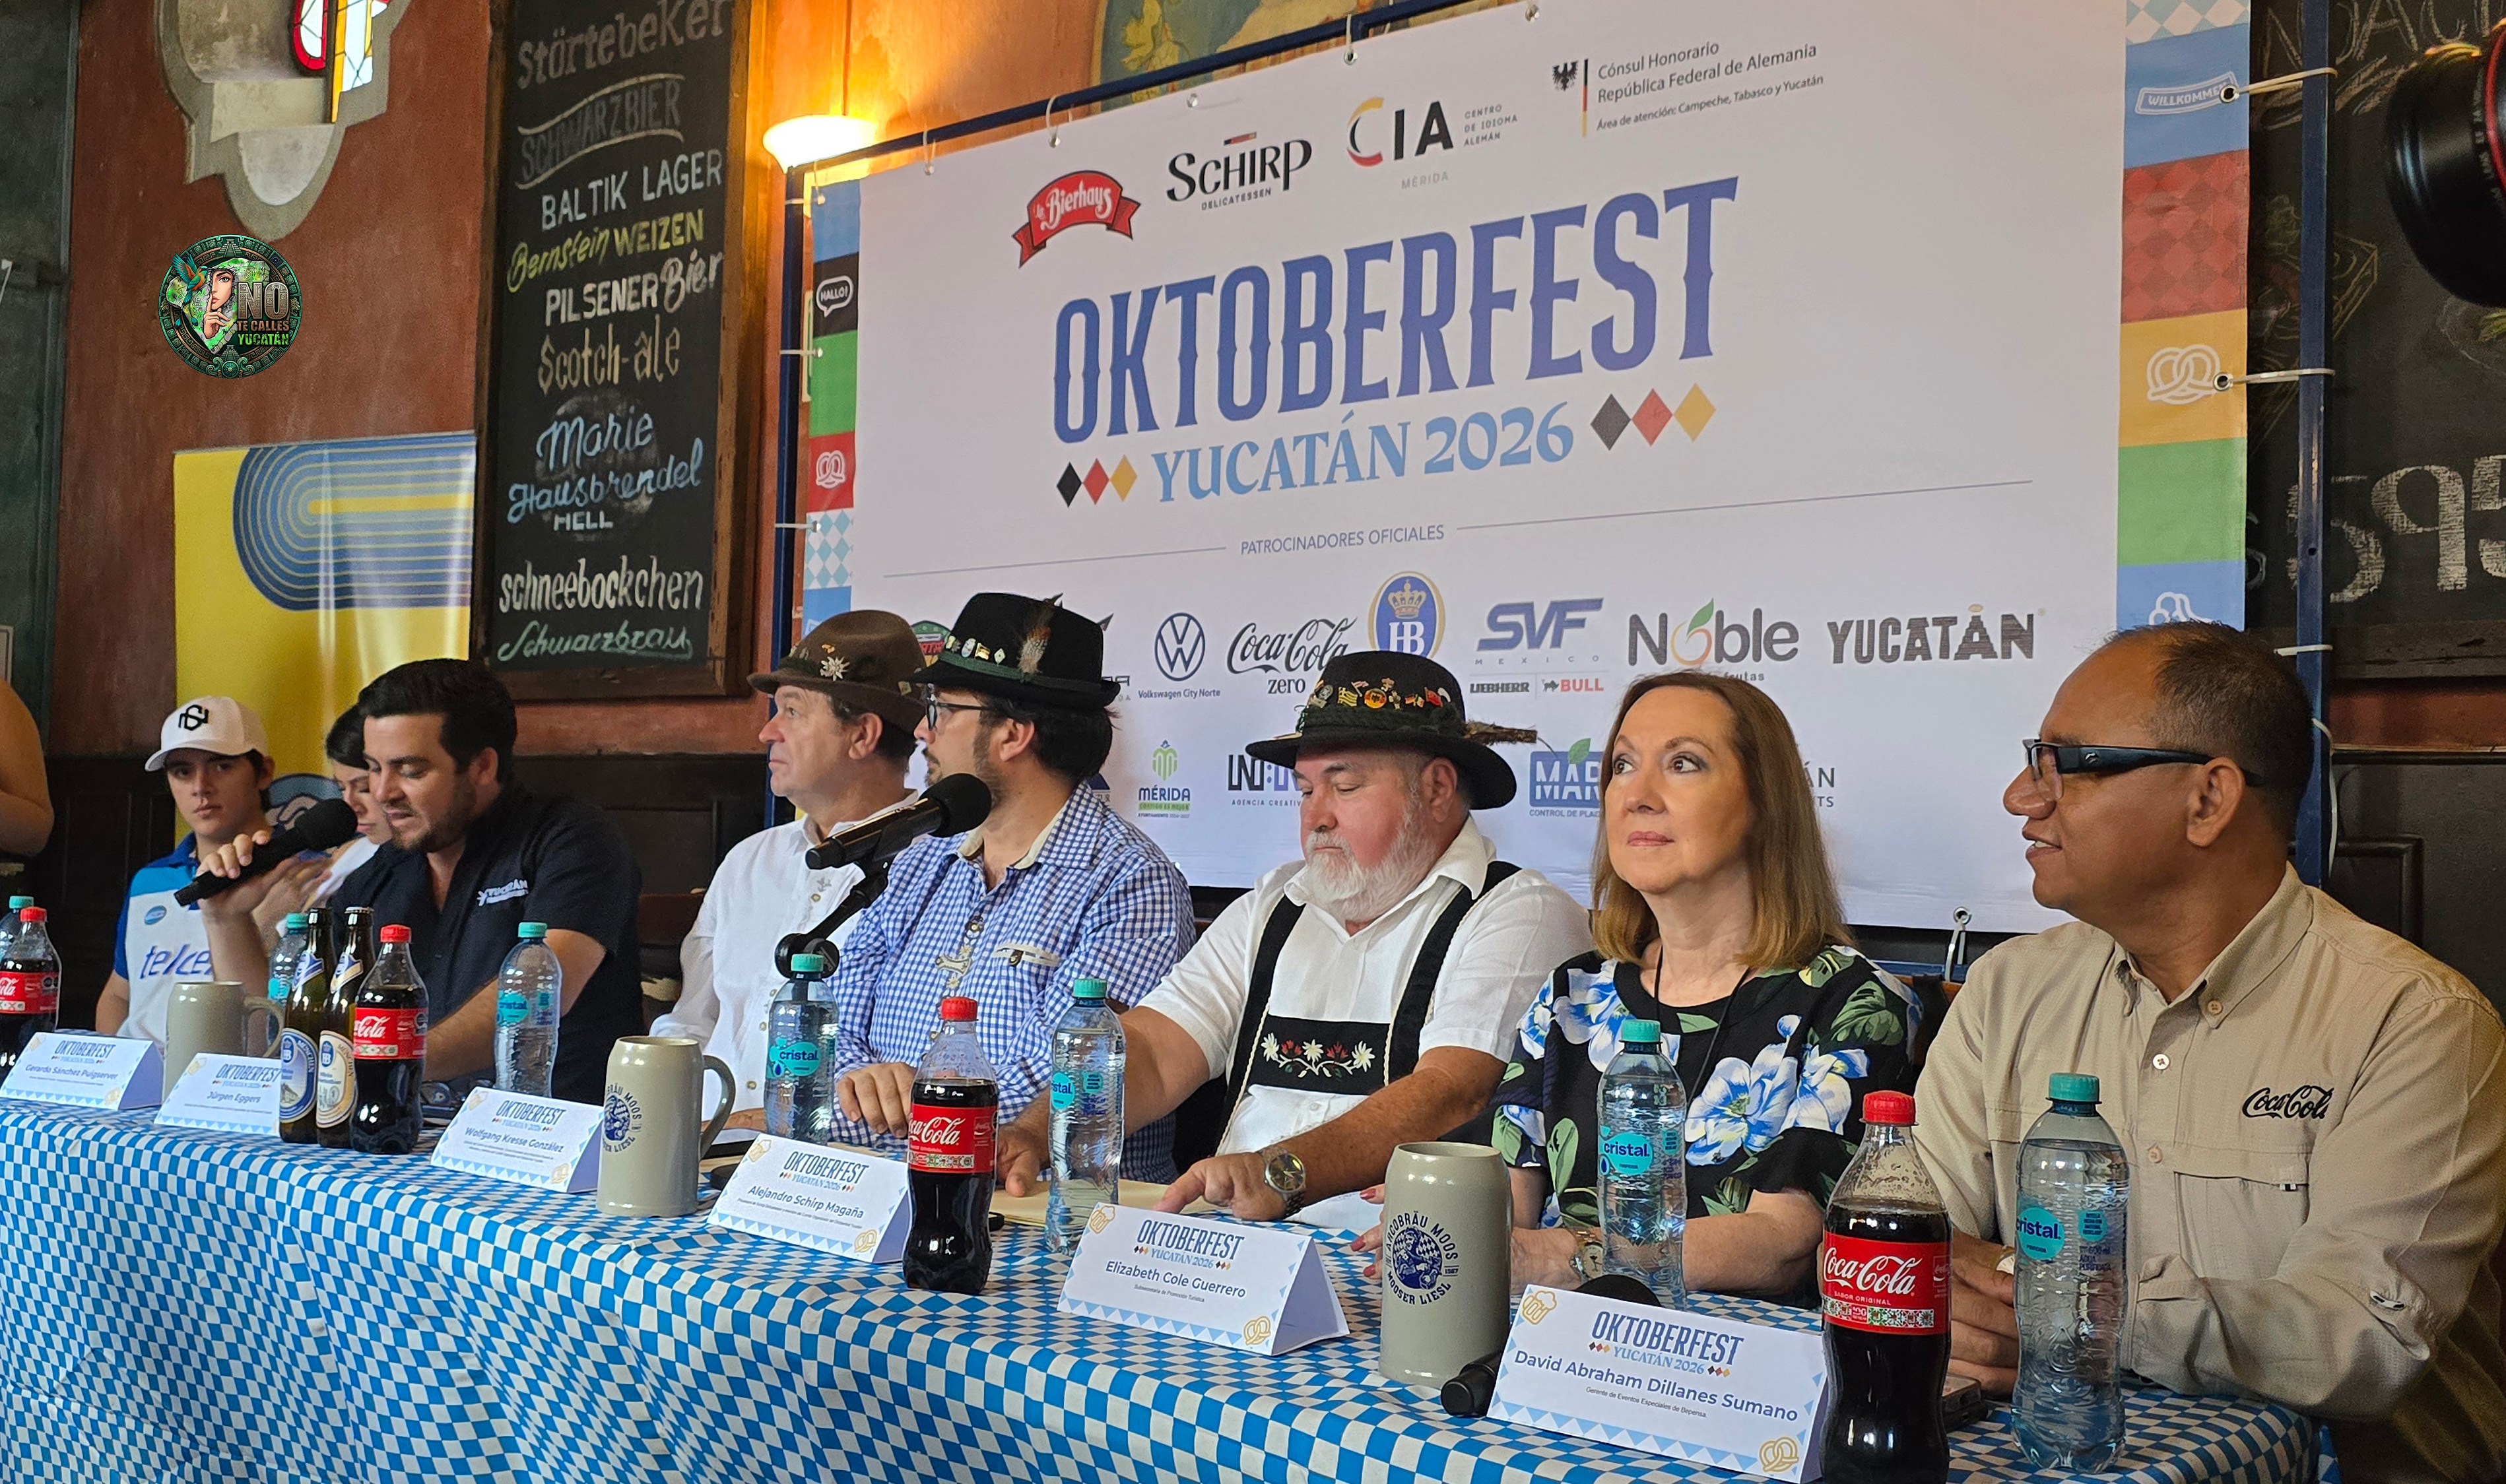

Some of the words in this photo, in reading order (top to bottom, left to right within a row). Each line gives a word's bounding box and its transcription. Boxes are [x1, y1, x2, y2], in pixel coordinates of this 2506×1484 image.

[1598, 55, 1645, 80] Cónsul
[1649, 41, 1719, 69] Honorario
[1598, 76, 1665, 103] República
[1668, 62, 1721, 88] Federal
[1724, 59, 1742, 77] de
[1746, 43, 1817, 71] Alemania
[1464, 104, 1502, 119] CENTRO
[1620, 114, 1632, 127] de
[1734, 84, 1773, 103] Tabasco
[1775, 84, 1782, 98] y
[1782, 75, 1824, 93] Yucatán
[1464, 122, 1476, 133] DE
[1480, 114, 1518, 129] IDIOMA
[1464, 131, 1501, 147] ALEMÁN
[541, 170, 628, 232] BALTIK
[642, 148, 723, 201] LAGER
[1401, 171, 1449, 190] MÉRIDA
[1201, 187, 1272, 211] DELICATESSEN
[613, 209, 704, 257] WEIZEN
[545, 273, 659, 327] PILSENER
[660, 248, 723, 313] Bier
[820, 286, 848, 302] HALLO!
[1053, 176, 1738, 445] OKTOBERFEST
[1150, 410, 1413, 503] YUCATÁN
[1424, 401, 1575, 476] 2026
[554, 510, 614, 532] HELL
[1240, 530, 1364, 556] PATROCINADORES
[1368, 525, 1445, 544] OFICIALES
[1476, 598, 1604, 652] SVF
[1138, 690, 1183, 700] Volkswagen
[1183, 688, 1198, 699] City
[1199, 688, 1220, 697] Norte
[1267, 678, 1306, 695] zero
[1470, 682, 1530, 694] LIEBHERR
[1560, 678, 1604, 692] BULL
[1138, 784, 1191, 802] MÉRIDA
[55, 1040, 116, 1059] OKTOBERFEST
[52, 1065, 81, 1077] Sánchez
[496, 1100, 567, 1126] OKTOBERFEST
[465, 1126, 502, 1142] Wolfgang
[502, 1136, 527, 1147] Kresse
[529, 1138, 564, 1153] González
[783, 1151, 870, 1184] OKTOBERFEST
[791, 1171, 825, 1188] YUCATÁN
[748, 1186, 793, 1204] Alejandro
[794, 1194, 824, 1211] Schirp
[826, 1201, 865, 1219] Magaña
[1137, 1219, 1245, 1260] OKTOBERFEST
[1430, 1223, 1459, 1260] MOOS
[1150, 1248, 1194, 1266] YUCATÁN
[1192, 1255, 1214, 1269] 2026
[1824, 1247, 1923, 1297] Coca-Cola
[1105, 1260, 1160, 1282] Elizabeth
[1163, 1272, 1189, 1287] Cole
[1191, 1277, 1246, 1299] Guerrero
[1387, 1270, 1416, 1305] MOOSER
[1419, 1282, 1452, 1305] LIESL
[1834, 1291, 1854, 1301] SABOR
[1855, 1295, 1892, 1306] ORIGINAL
[1591, 1311, 1744, 1365] OKTOBERFEST
[1613, 1345, 1674, 1370] YUCATÁN
[1674, 1358, 1705, 1374] 2026
[1514, 1350, 1563, 1373] David
[1564, 1361, 1643, 1390] Abraham
[1647, 1378, 1718, 1405] Dillanes
[1721, 1393, 1798, 1422] Sumano
[1586, 1386, 1608, 1397] Gerente
[1617, 1393, 1639, 1403] Eventos
